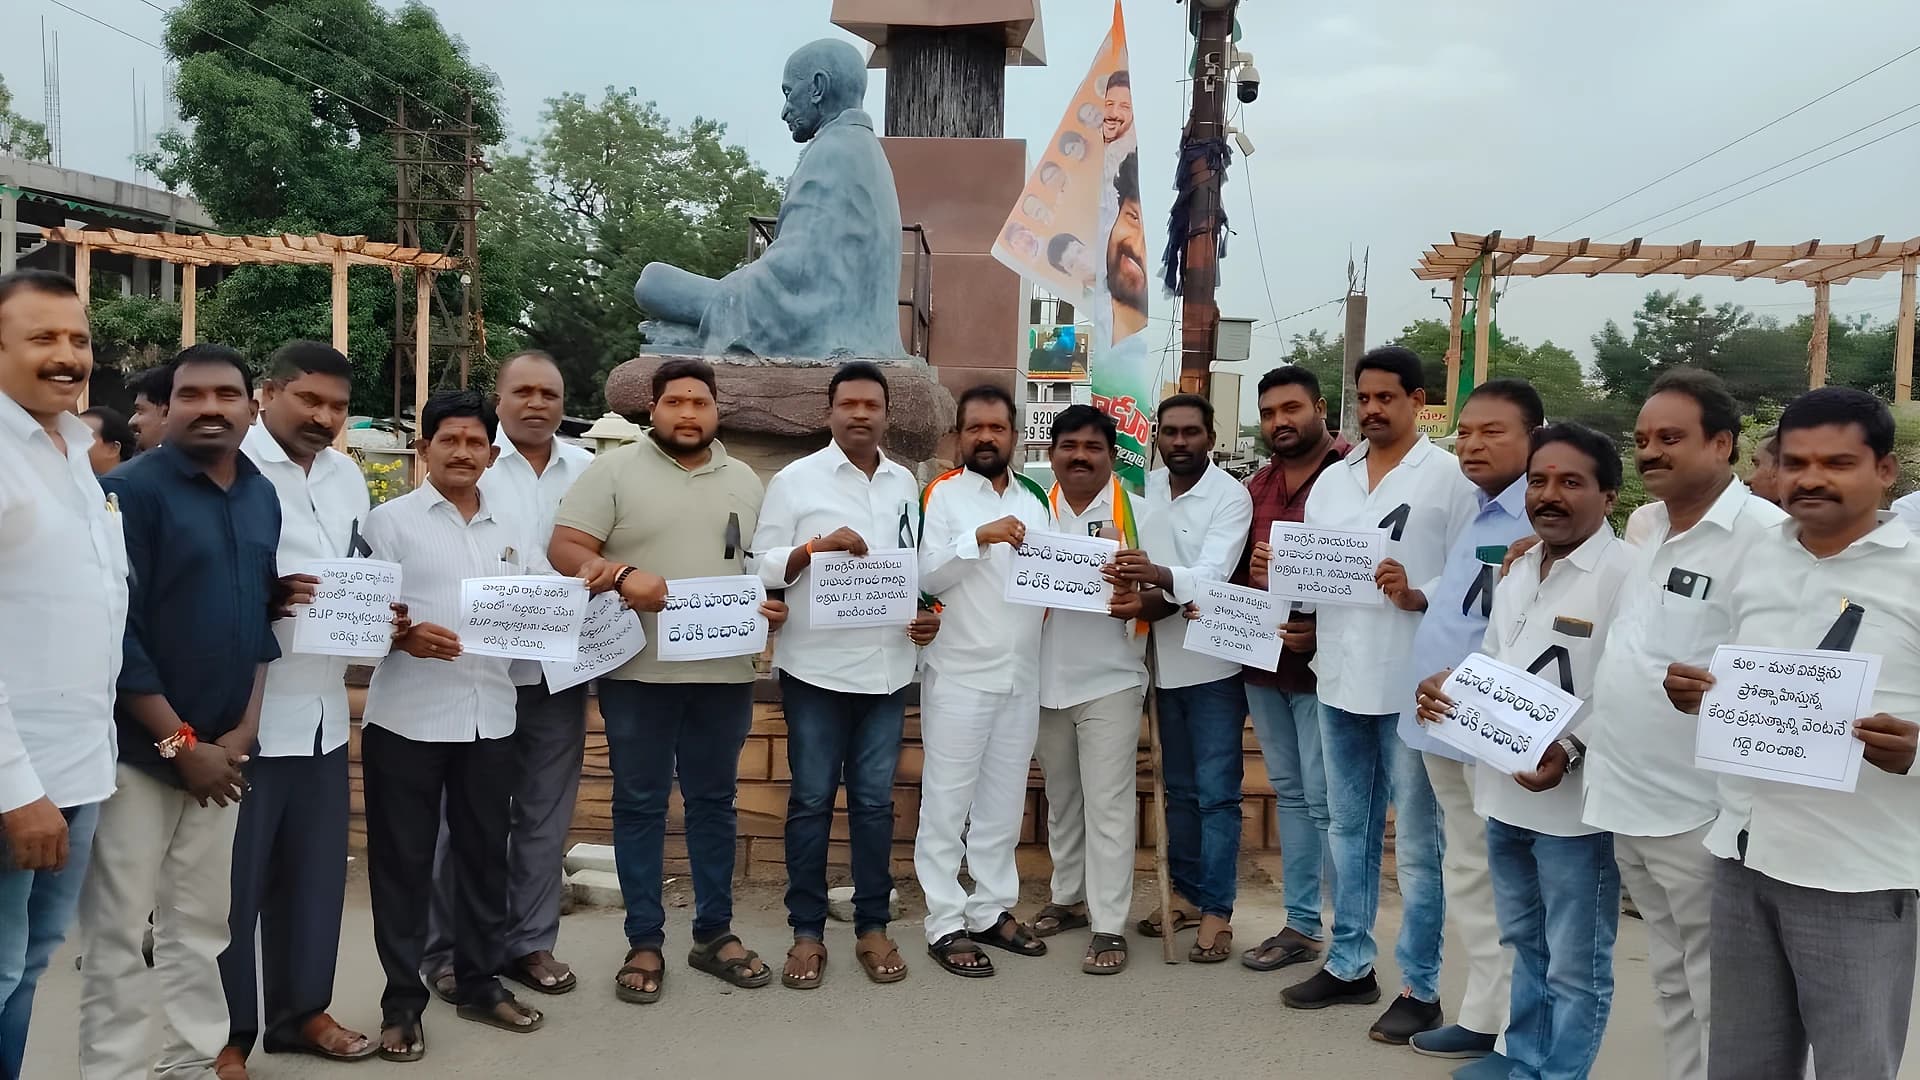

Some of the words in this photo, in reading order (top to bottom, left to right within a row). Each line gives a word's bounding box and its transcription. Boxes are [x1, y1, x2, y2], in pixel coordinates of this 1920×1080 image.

[1318, 536, 1369, 549] నాయకులు
[308, 608, 334, 620] BJP
[469, 617, 491, 627] BJP
[1732, 657, 1756, 671] కుల
[1768, 661, 1796, 676] మత
[1797, 665, 1843, 685] వివక్షను
[1737, 682, 1824, 711] ప్రోత్సాహిస్తున్న
[1708, 702, 1737, 725] కేంద్ర
[1736, 710, 1799, 736] ప్రభుత్వాన్ని
[1801, 718, 1849, 737] వెంటనే
[1755, 741, 1808, 759] దించాలి.
